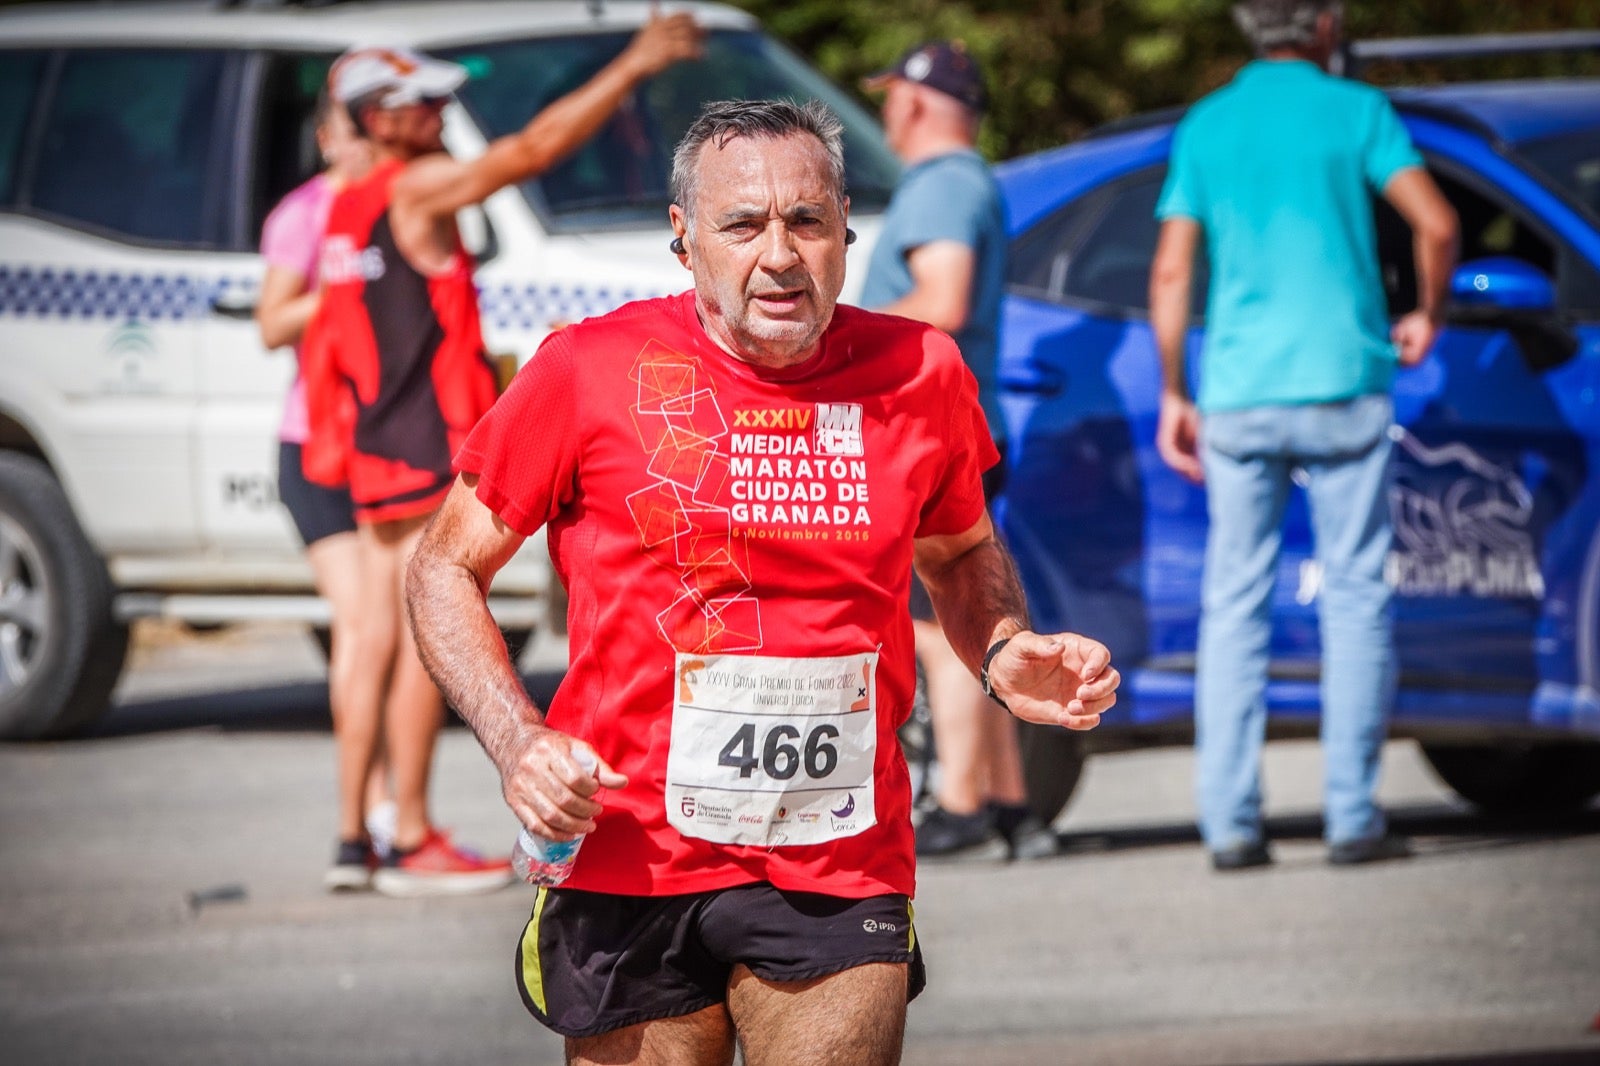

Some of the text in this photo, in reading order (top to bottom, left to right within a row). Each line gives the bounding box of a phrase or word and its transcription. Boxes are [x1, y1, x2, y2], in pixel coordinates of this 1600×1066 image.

[733, 408, 811, 429] XXXIV
[731, 433, 810, 455] MEDIA
[730, 456, 867, 480] MARATÓN
[730, 481, 869, 502] CIUDAD DE
[731, 503, 872, 525] GRANADA
[747, 527, 829, 540] Noviembre
[836, 529, 870, 541] 2016
[705, 670, 731, 688] XXXV
[836, 672, 857, 688] 2022
[718, 723, 840, 781] 466
